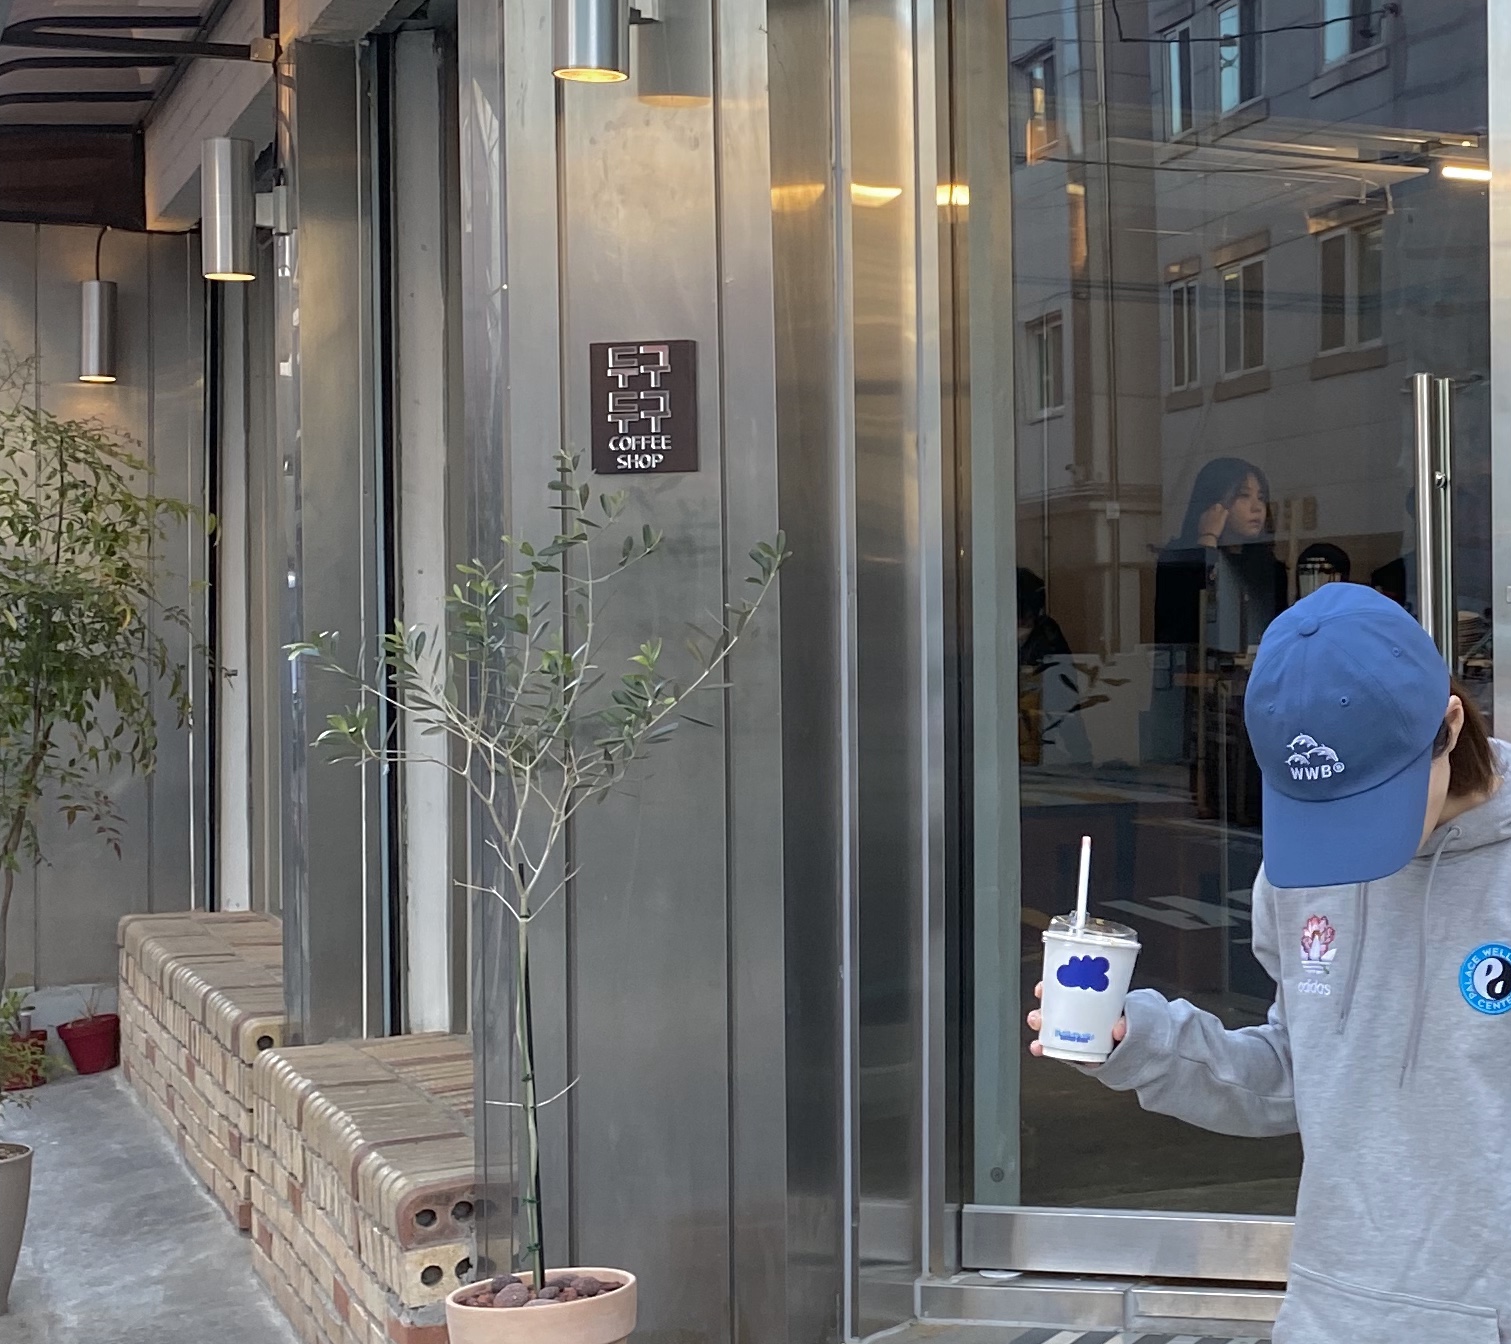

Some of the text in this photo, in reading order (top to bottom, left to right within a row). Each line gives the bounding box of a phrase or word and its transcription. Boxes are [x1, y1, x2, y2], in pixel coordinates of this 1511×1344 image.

[608, 434, 672, 451] COFFEE
[616, 453, 664, 470] SHOP
[1464, 955, 1481, 999] PALACE
